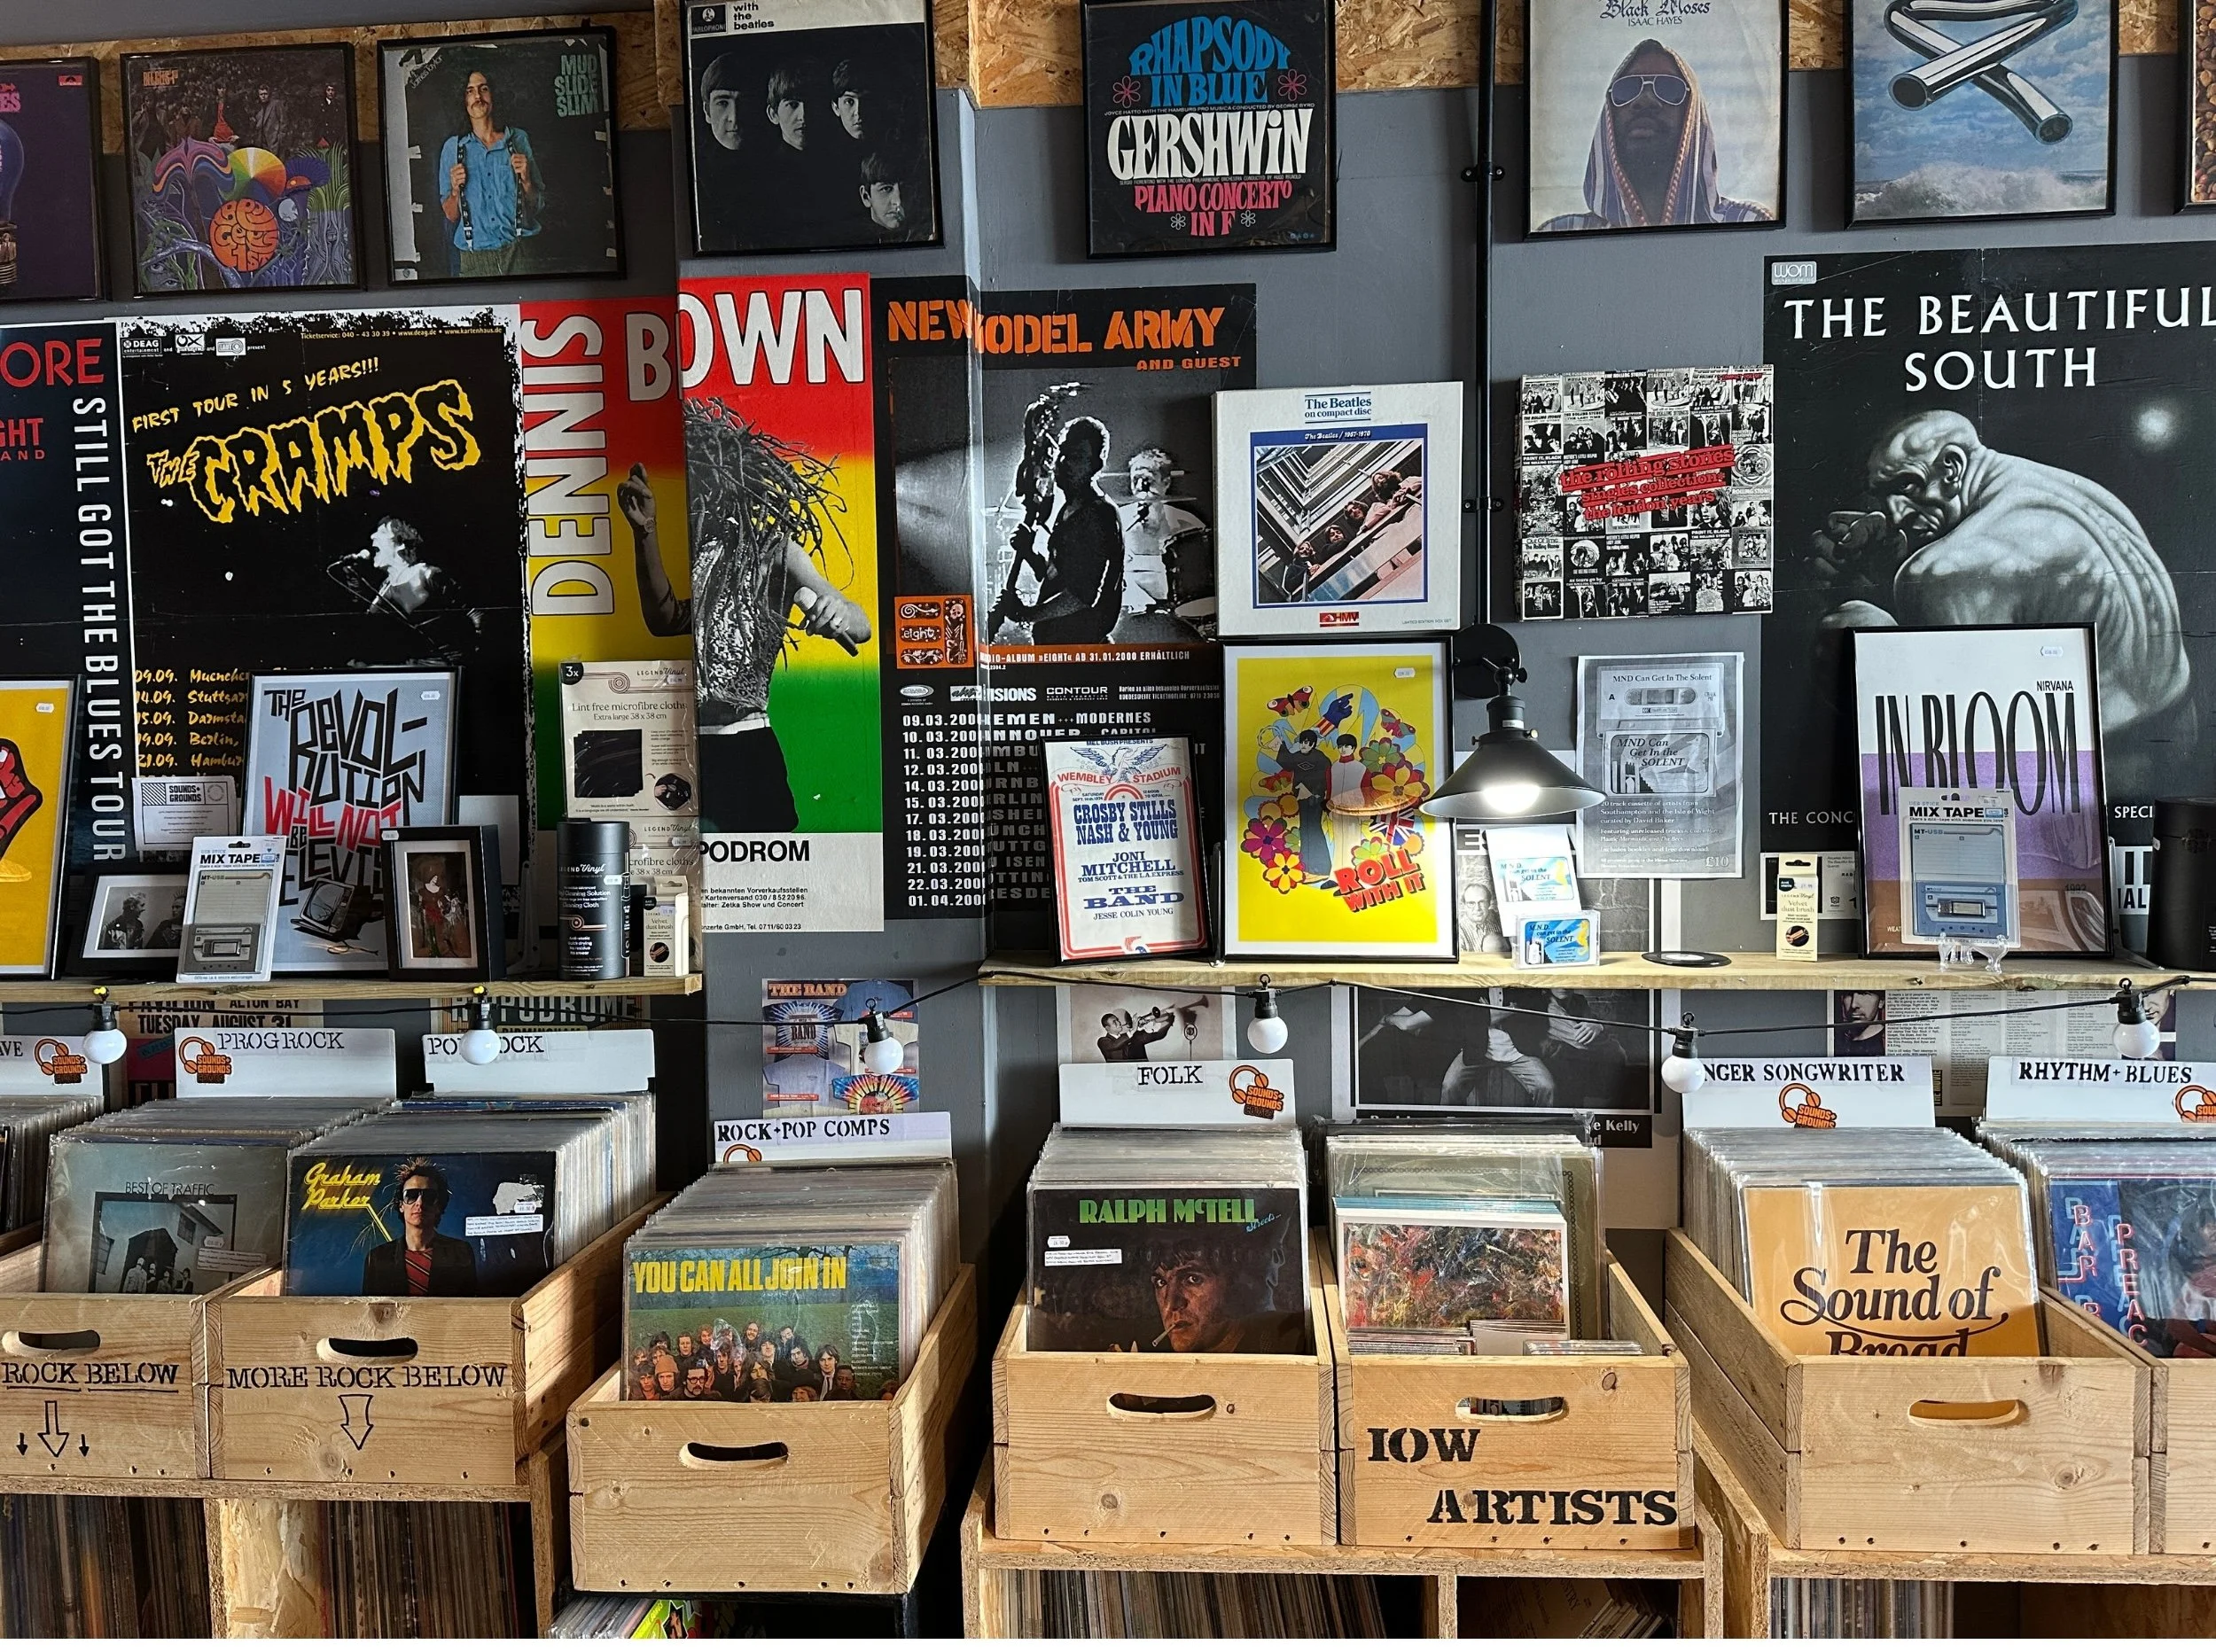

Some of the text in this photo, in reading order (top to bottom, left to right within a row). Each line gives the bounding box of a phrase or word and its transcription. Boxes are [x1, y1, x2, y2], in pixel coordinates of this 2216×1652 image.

[733, 3, 759, 12] with
[1600, 0, 1710, 19] Black Moses
[734, 19, 775, 30] beatles
[1627, 16, 1682, 27] ISAAC HAYES
[1129, 16, 1291, 75] RHAPSODY
[561, 54, 598, 76] MUD
[554, 75, 598, 97] SLIDE
[1151, 71, 1268, 107] IN BLUE
[556, 96, 599, 117] SLIM
[1135, 180, 1292, 213] PIANO CONCERTO
[1190, 211, 1236, 236] IN F
[1783, 286, 2216, 339] THE BEAUTIFUL
[887, 299, 974, 342] NEW
[1104, 307, 1225, 350] ARMY
[0, 338, 105, 388] ORE
[1136, 356, 1241, 371] AND GUEST
[1905, 347, 2096, 392] SOUTH
[133, 356, 379, 432] FIRST TOUR IN 5 YEARS!!!
[1305, 397, 1371, 409] The Beatles
[1316, 407, 1371, 419] compact disc
[146, 378, 481, 524] THE CRAMPS
[520, 289, 865, 618] DENNIS BOWN
[1560, 449, 1735, 487] the rolling stones
[1581, 483, 1638, 503] singles
[1584, 492, 1716, 521] the london years
[74, 397, 126, 861] STILL GOT THE BLUES TOUR
[1089, 649, 1190, 662] 31.01.2000 ERHÄLTLICH
[566, 666, 579, 677] 3x
[1047, 686, 1108, 695] CONTOUR
[2036, 680, 2073, 691] NIRVANA
[264, 690, 306, 721] THE
[572, 701, 687, 712] Lint free microfibre cloths
[1076, 713, 1151, 724] MODERNES
[1617, 738, 1668, 747] MND Can
[1629, 747, 1678, 757] Get the
[1641, 758, 1684, 767] SOLENT
[1876, 696, 1912, 815] IN
[1057, 767, 1181, 784] WEMBLEY STADIUM
[264, 775, 335, 837] WILL
[337, 800, 402, 851] NOT
[1073, 799, 1177, 824] CROSBY STILLS
[1768, 812, 1799, 825] THE
[1909, 807, 1985, 818] MIX TAPE
[2114, 806, 2153, 819] SPECI
[1076, 820, 1178, 845] NASH & YOUNG
[200, 853, 261, 864] MIX TAPE
[666, 857, 694, 866] cloths
[1112, 851, 1145, 862] JONI
[1705, 856, 1729, 868] £10
[1081, 859, 1176, 877] MITCHELL
[1334, 849, 1420, 895] ROLL
[1109, 885, 1157, 895] THE
[1343, 872, 1426, 913] WITH IT
[1083, 892, 1185, 909] BAND
[1093, 908, 1174, 921] JESSE COLIN YOUNG
[769, 982, 847, 996] THE BAND
[217, 1031, 345, 1049] PROG ROCK
[54, 1064, 86, 1074] GROUNDS
[198, 1064, 231, 1073] GROUNDS
[1137, 1065, 1203, 1087] FOLK
[1764, 1064, 1905, 1082] SONGWRITER
[2019, 1062, 2192, 1084] RHYTHM BLUES
[1246, 1095, 1283, 1110] GROUNDS
[824, 1118, 890, 1138] COMPS
[1605, 1118, 1640, 1135] Kelly
[303, 1162, 381, 1187] Graham
[125, 1181, 215, 1196] BEST OF TRAFFIC
[301, 1186, 371, 1211] Parker
[1079, 1198, 1167, 1224] RALPH
[1845, 1228, 1938, 1274] The
[633, 1256, 847, 1293] YOU CAN ALL JOIN IN
[1781, 1266, 2001, 1325] Sound of
[2, 1362, 178, 1385] ROCK BELOW
[226, 1365, 508, 1389] MORE ROCK BELOW
[1367, 1428, 1481, 1462] IOW
[1426, 1490, 1678, 1526] ARTISTS
